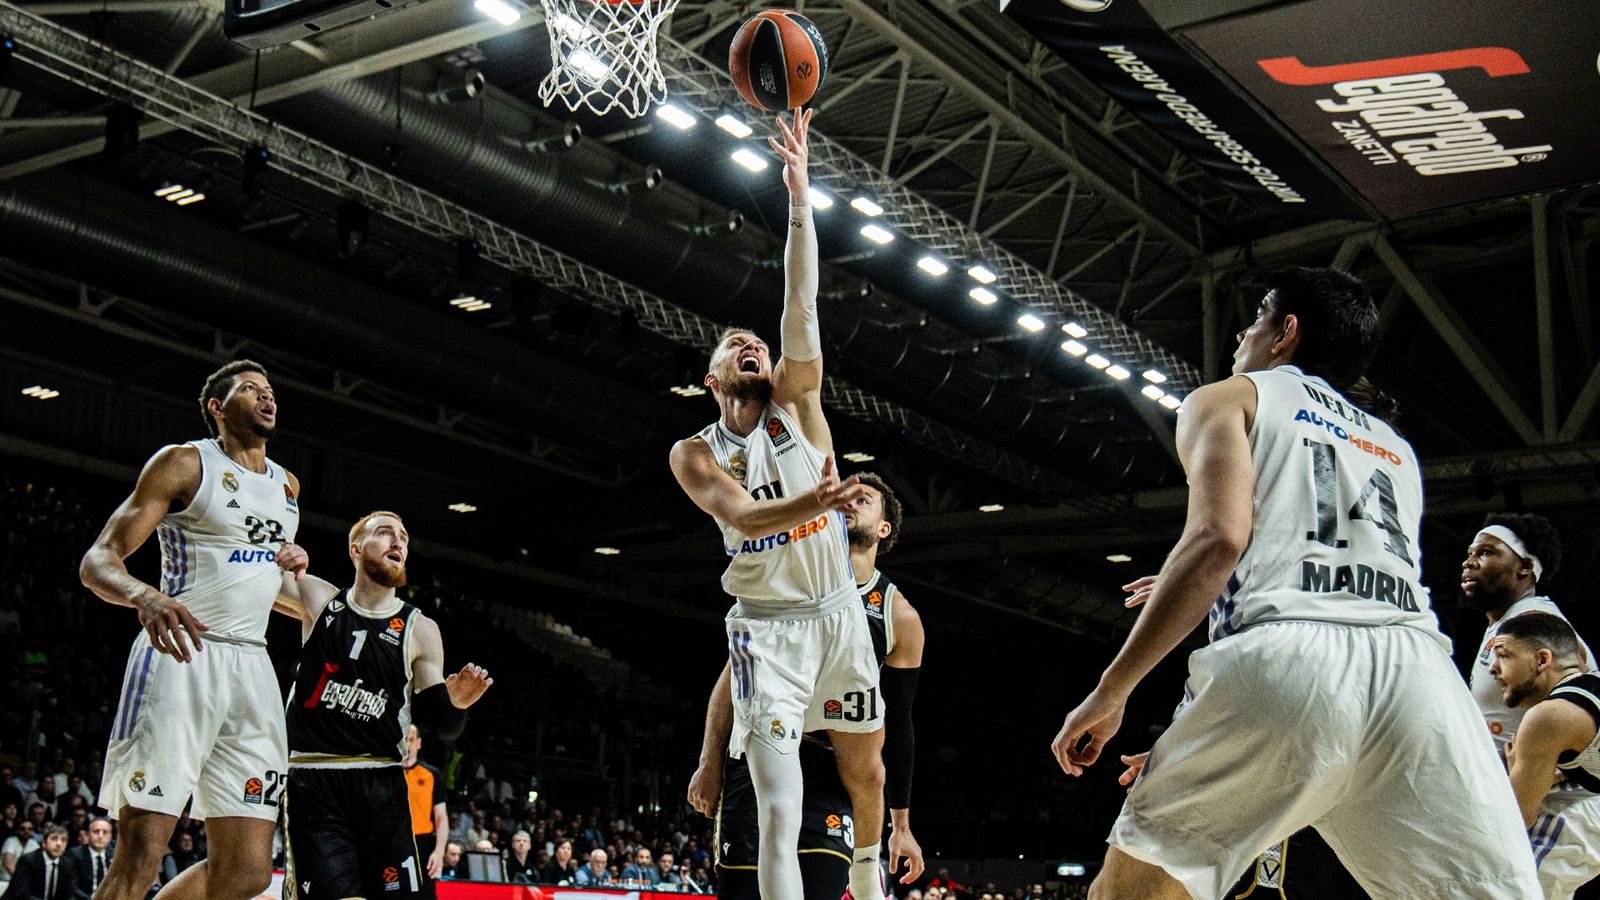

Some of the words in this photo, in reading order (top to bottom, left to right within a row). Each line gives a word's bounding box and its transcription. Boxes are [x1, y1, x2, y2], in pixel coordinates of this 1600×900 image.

[1099, 44, 1176, 93] ARENA
[1156, 92, 1254, 164] SEGAFREDO
[1258, 47, 1553, 176] Segafredo
[1332, 119, 1397, 166] ZANETTI
[1242, 157, 1306, 203] VIRTUS
[1295, 409, 1402, 466] AUTOHERO
[1303, 437, 1414, 569] 14
[245, 515, 286, 544] 22
[741, 515, 828, 554] AUTOHERO
[1303, 561, 1421, 613] MADRID
[349, 629, 367, 660] 1
[304, 662, 388, 719] Segafredo
[844, 686, 879, 722] 31
[401, 855, 419, 892] 1
